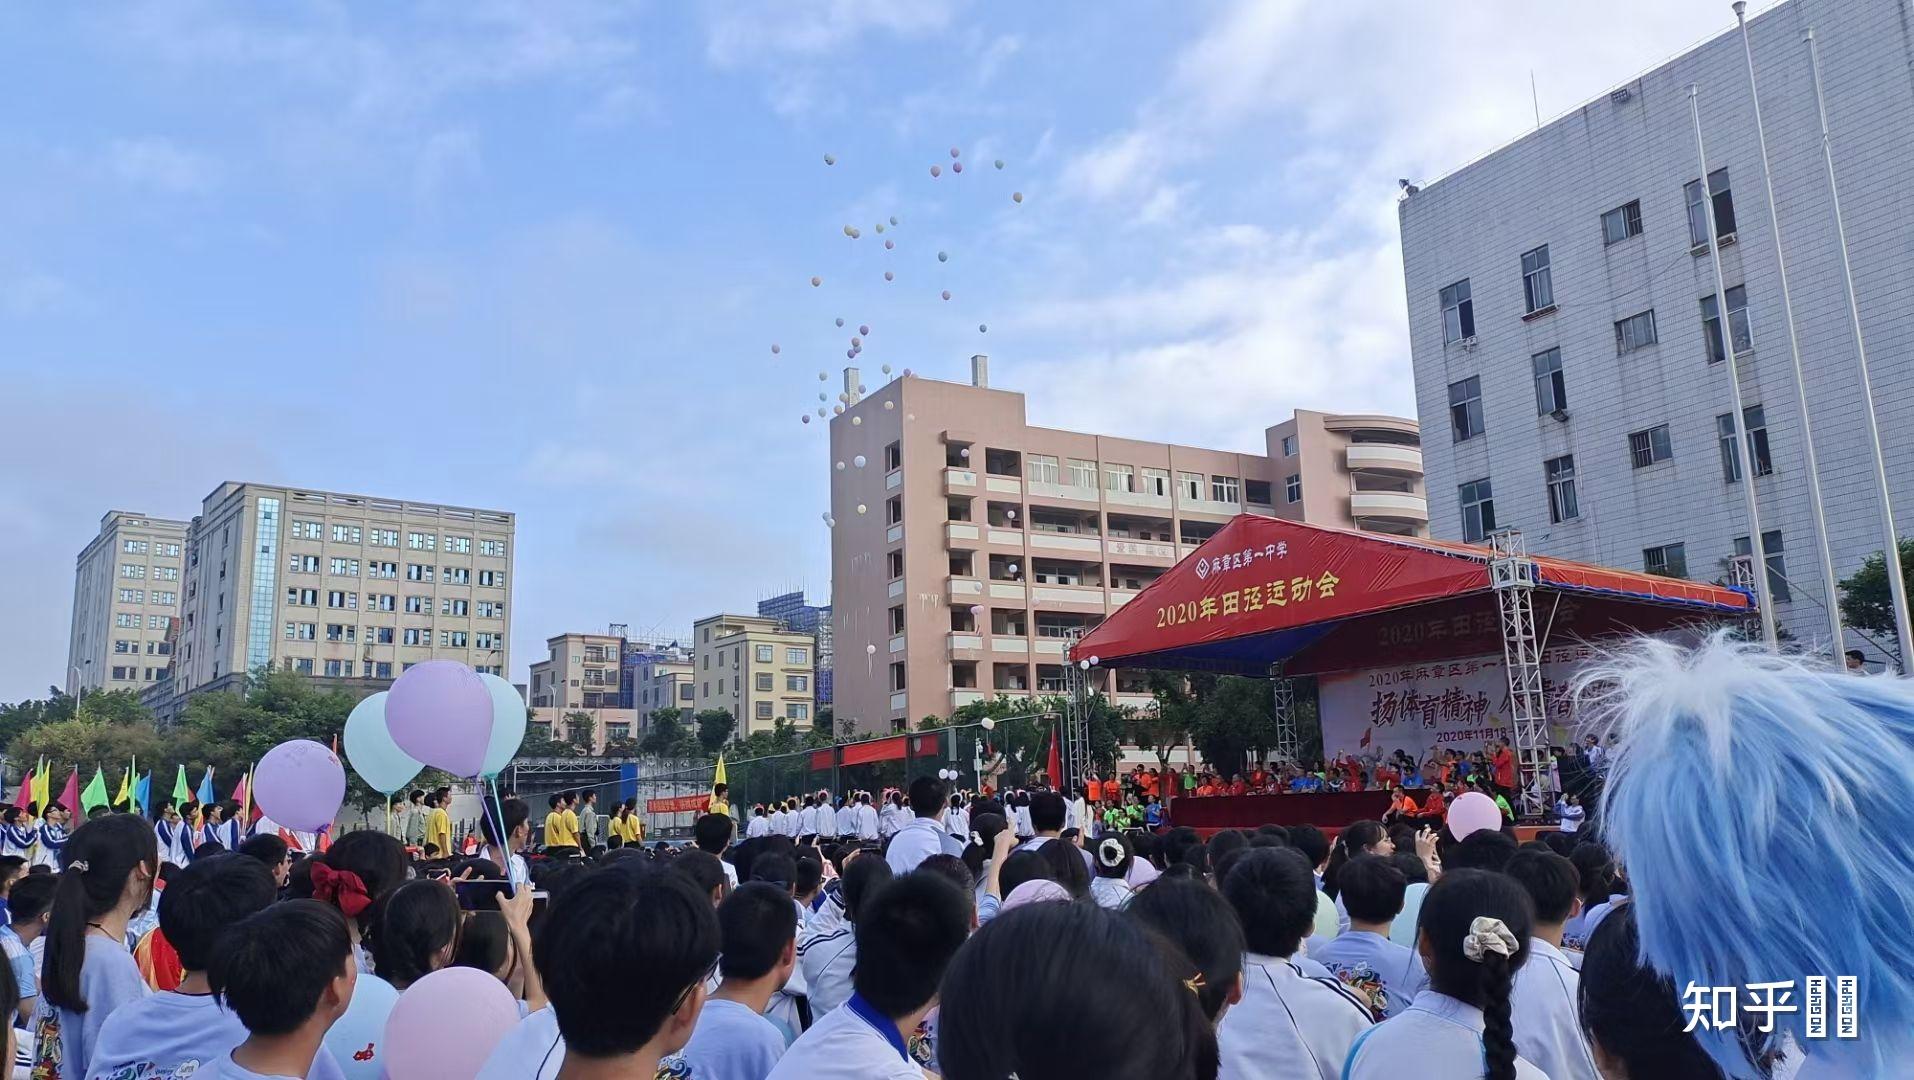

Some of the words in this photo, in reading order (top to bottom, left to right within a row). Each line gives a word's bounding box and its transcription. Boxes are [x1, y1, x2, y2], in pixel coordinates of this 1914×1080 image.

[1211, 540, 1288, 574] 麻章区第一中学
[1156, 570, 1340, 628] 2020年田径运动会
[1371, 686, 1490, 729] 扬体育精神
